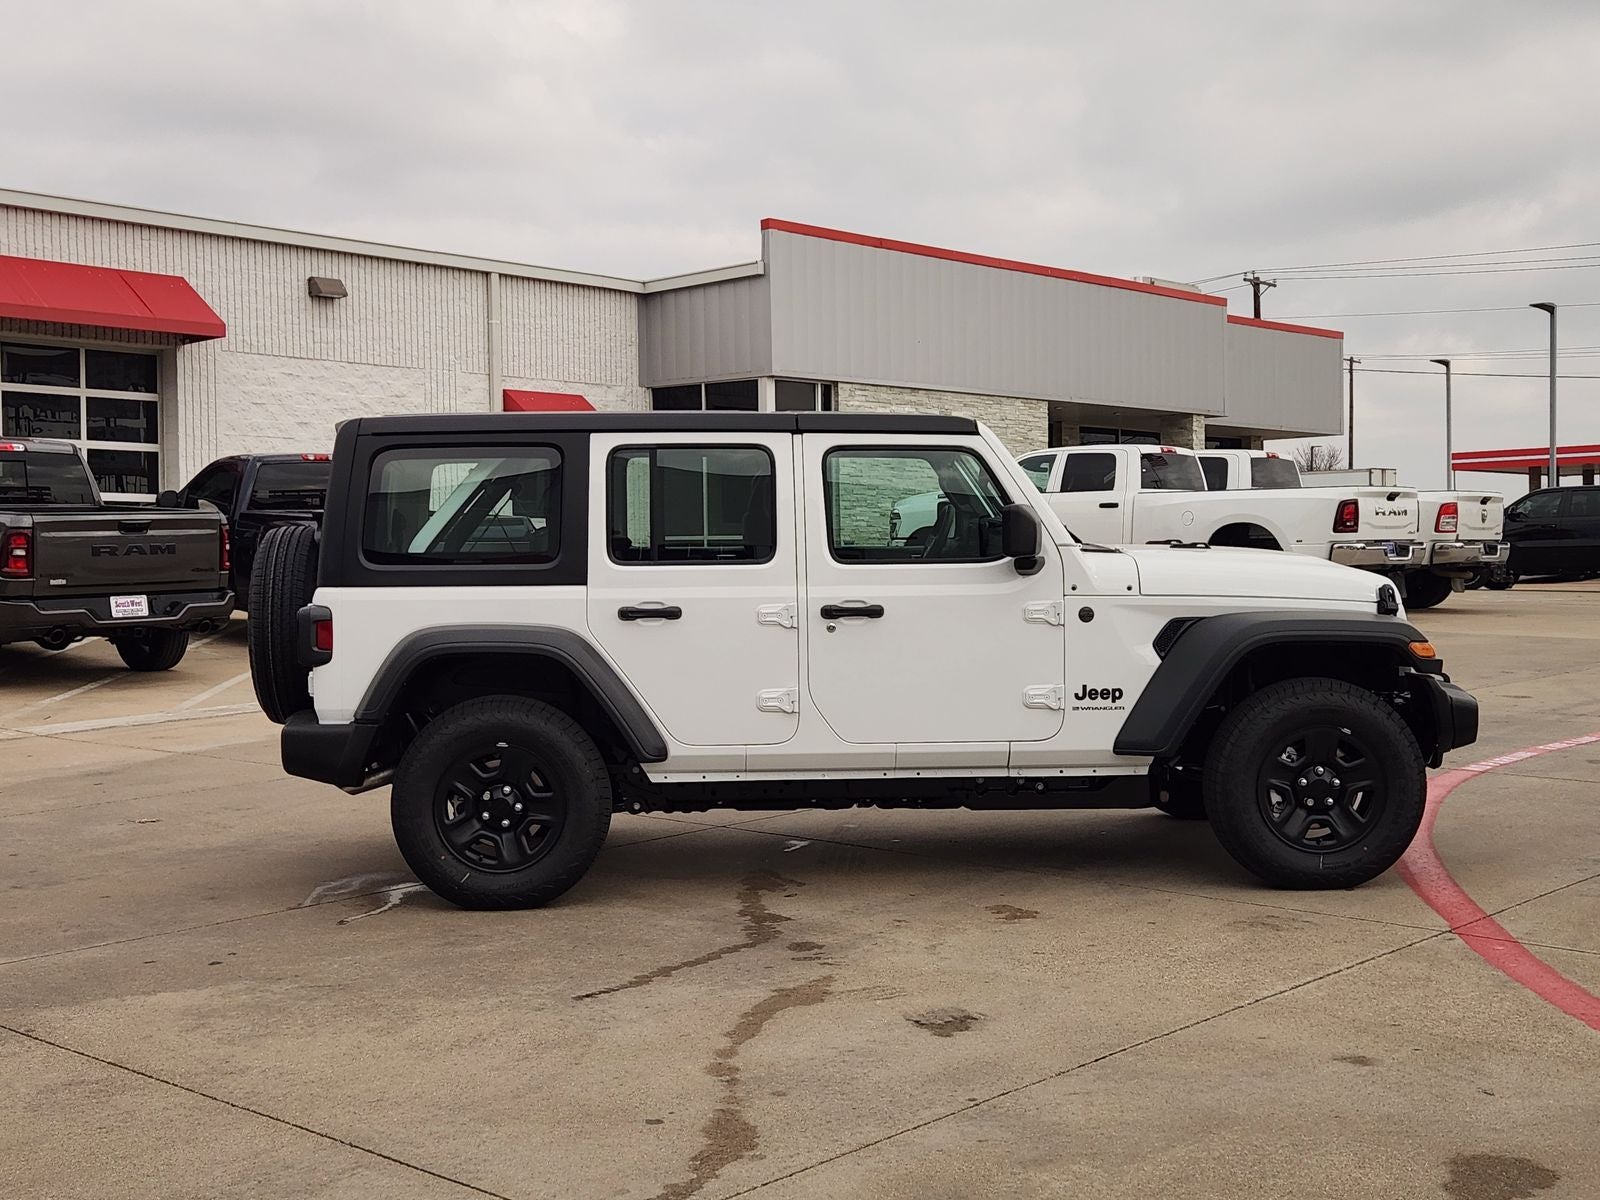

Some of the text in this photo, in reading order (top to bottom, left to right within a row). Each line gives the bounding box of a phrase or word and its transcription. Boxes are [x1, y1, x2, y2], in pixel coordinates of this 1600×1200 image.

[1374, 506, 1408, 517] RAM
[91, 543, 177, 557] RAM
[1074, 684, 1124, 703] Jeep
